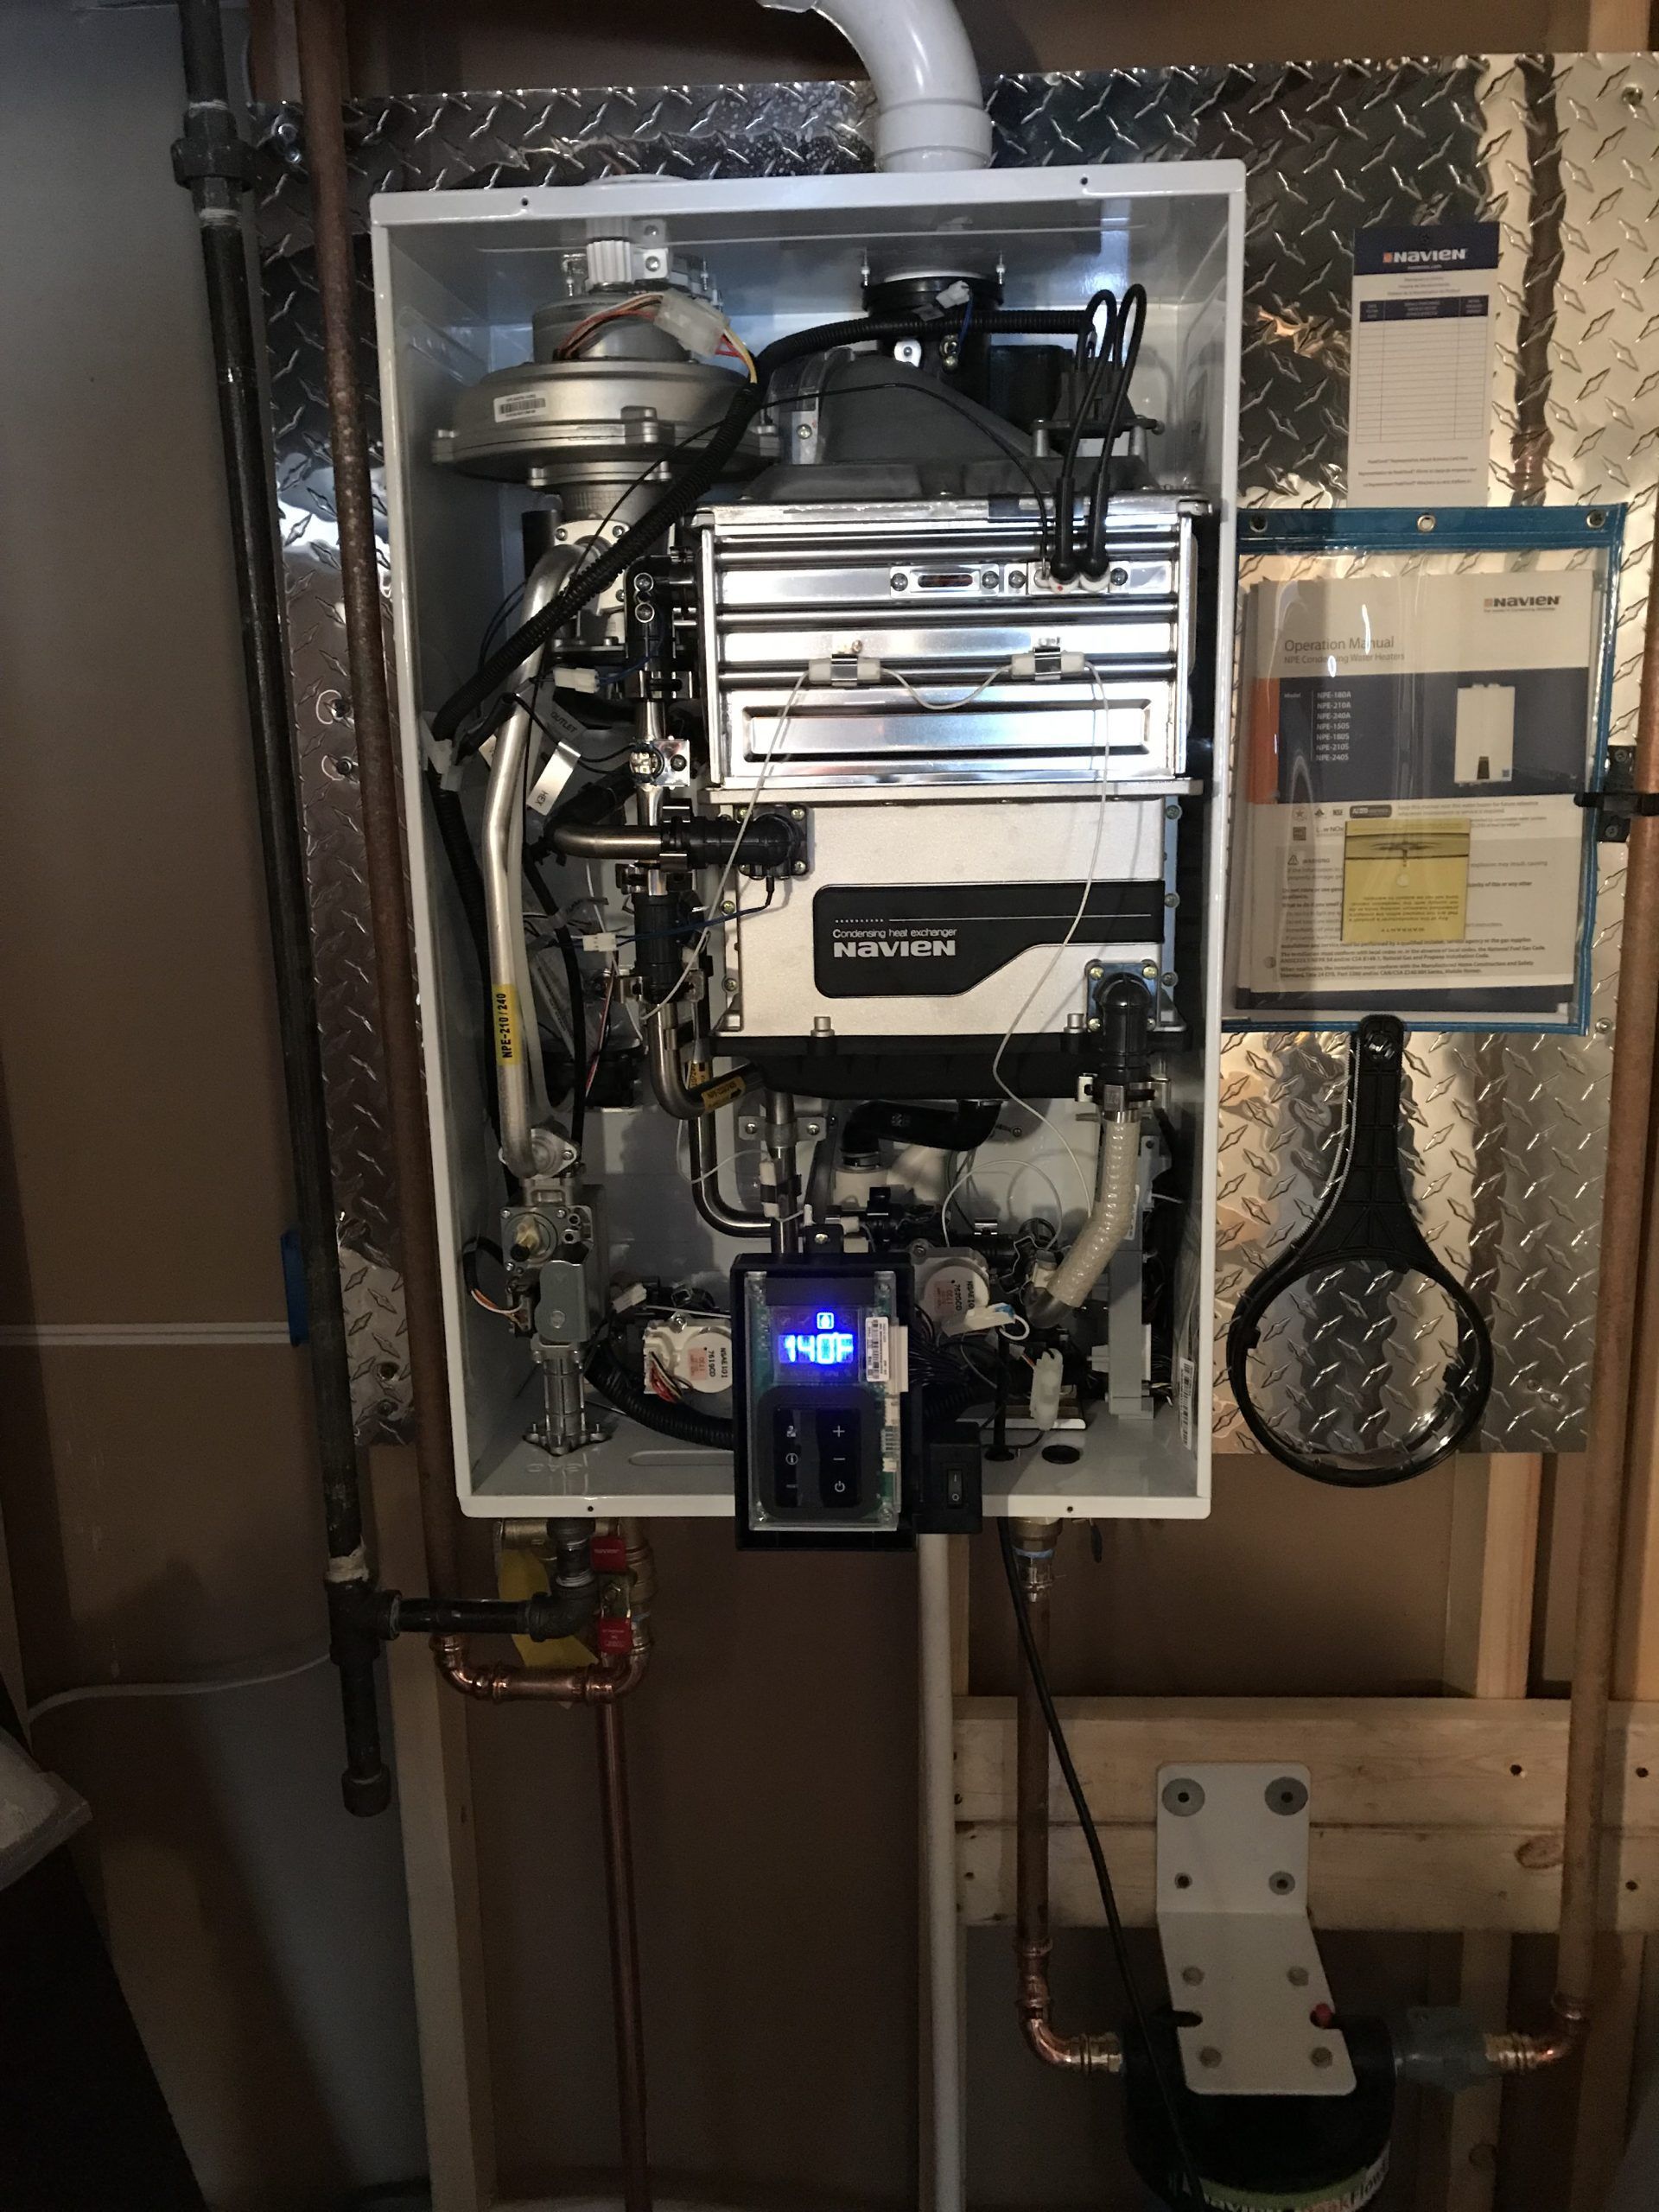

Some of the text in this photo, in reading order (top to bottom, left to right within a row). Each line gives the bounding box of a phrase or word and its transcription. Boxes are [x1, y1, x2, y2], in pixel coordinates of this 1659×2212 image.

[1284, 639, 1346, 653] Operation
[1284, 656, 1301, 664] NPE
[1351, 653, 1374, 663] Water
[1375, 652, 1405, 661] Heaters
[1317, 701, 1351, 709] NPE-210A
[550, 711, 578, 733] OUTLET
[534, 790, 550, 807] HEX
[832, 927, 957, 939] Condensing heat exchanger
[967, 1281, 976, 1310] NSAE10
[720, 1346, 729, 1380] NSAE101
